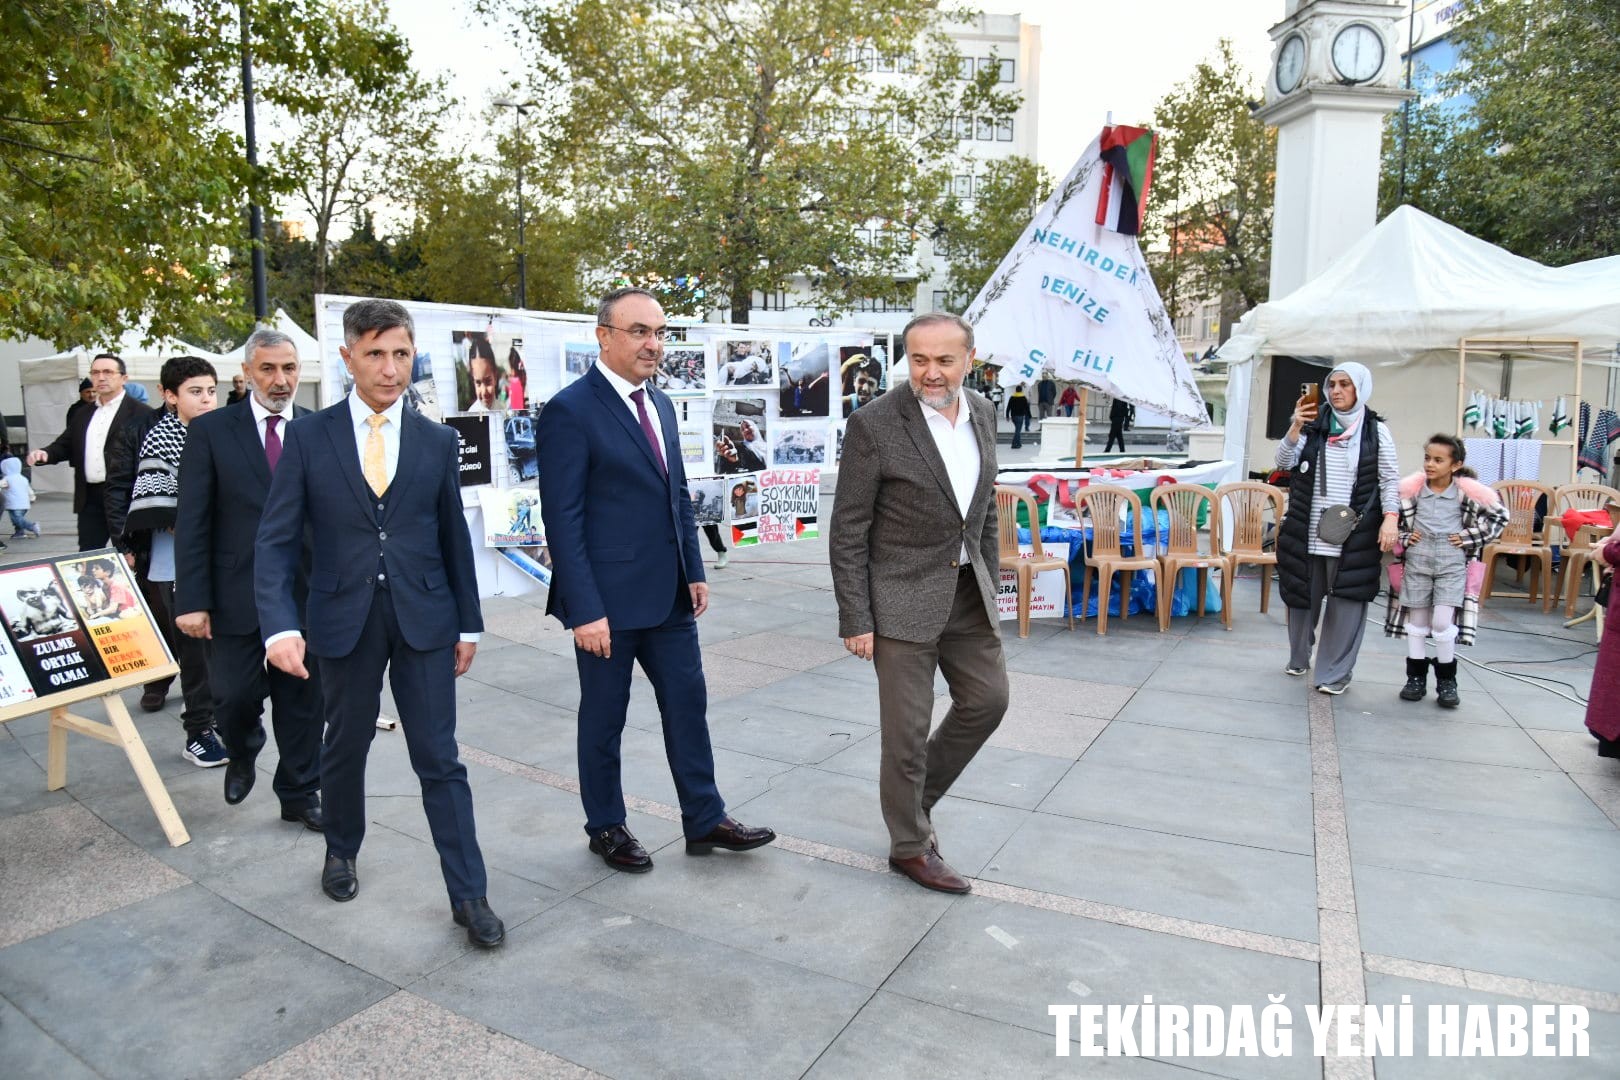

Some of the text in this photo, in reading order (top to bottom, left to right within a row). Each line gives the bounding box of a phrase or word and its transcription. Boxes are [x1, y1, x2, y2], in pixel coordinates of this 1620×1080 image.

[1041, 275, 1110, 323] DENİZE
[761, 500, 818, 515] DURDURUN
[93, 625, 112, 636] HER
[33, 637, 76, 656] ZULME
[41, 651, 85, 671] ORTAK
[112, 658, 149, 674] OLUYOR!
[50, 667, 89, 686] OLMA!
